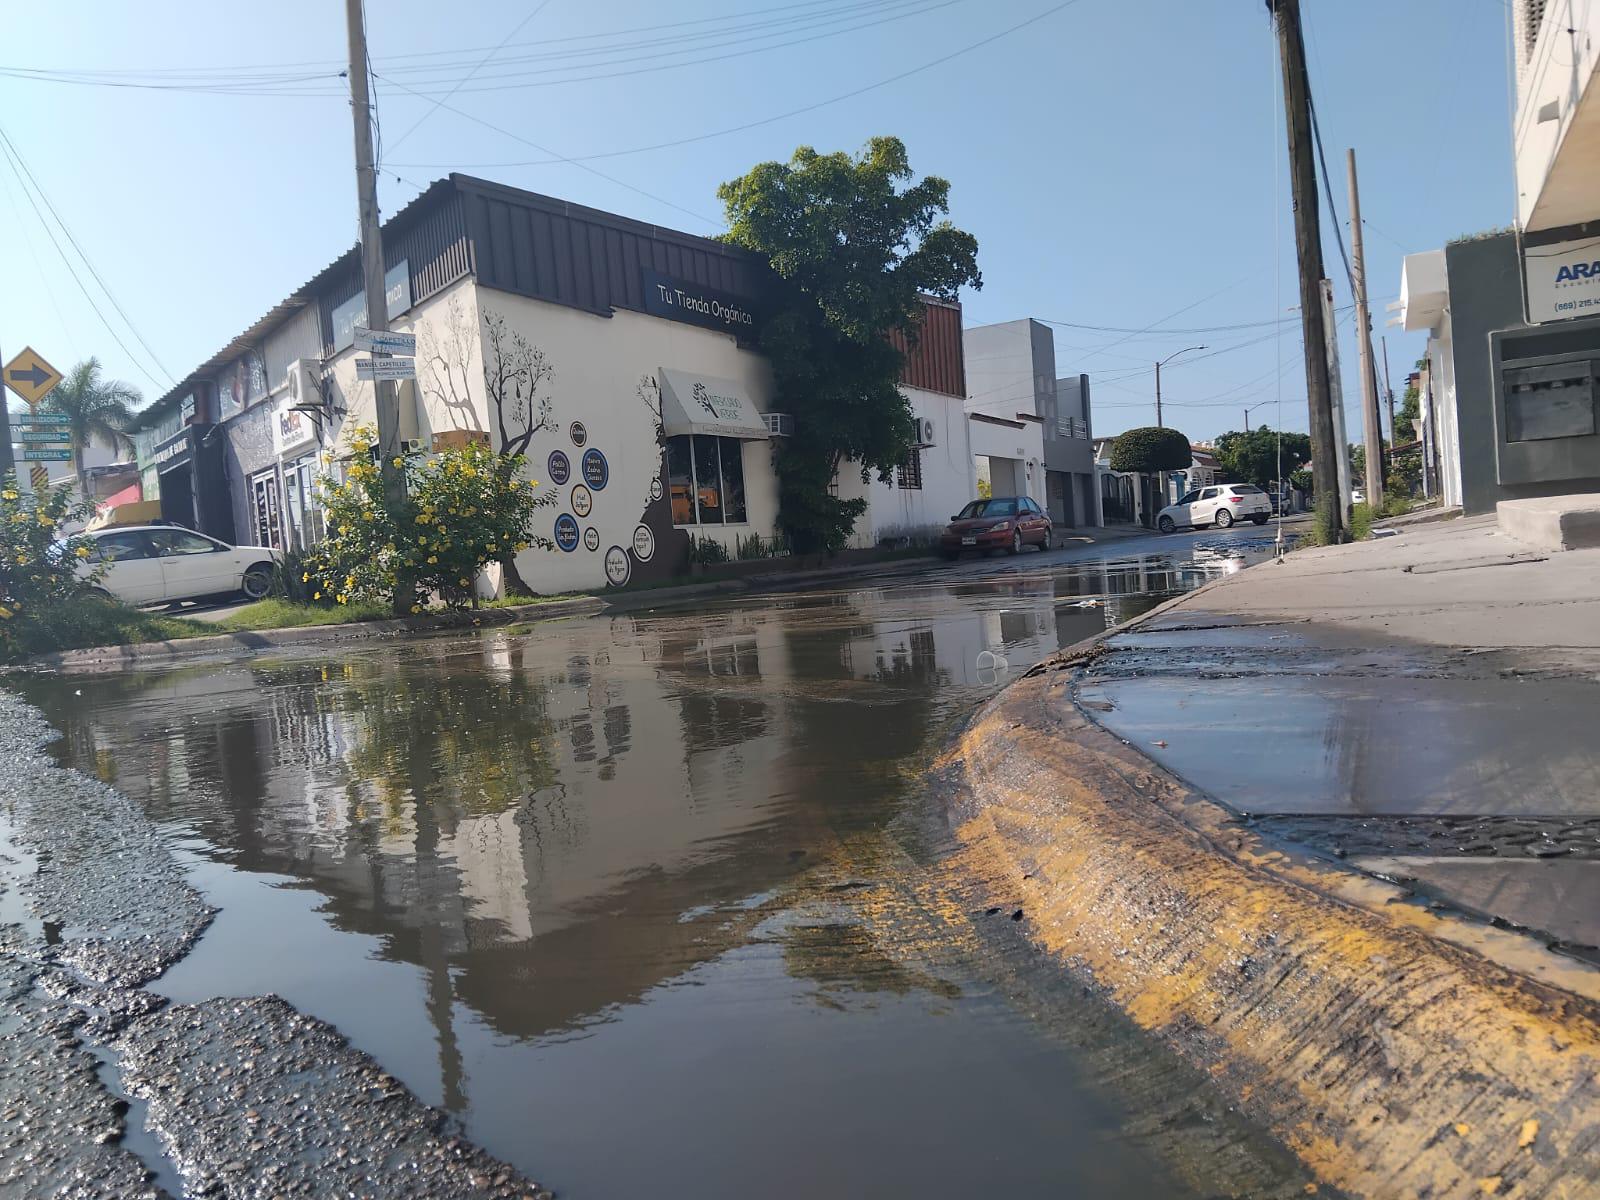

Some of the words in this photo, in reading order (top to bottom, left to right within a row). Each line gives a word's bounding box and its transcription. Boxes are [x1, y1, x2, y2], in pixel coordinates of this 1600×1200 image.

[657, 284, 672, 304] Tu
[674, 288, 709, 314] Tienda
[711, 300, 753, 325] Orgánica
[1554, 300, 1577, 313] (669)
